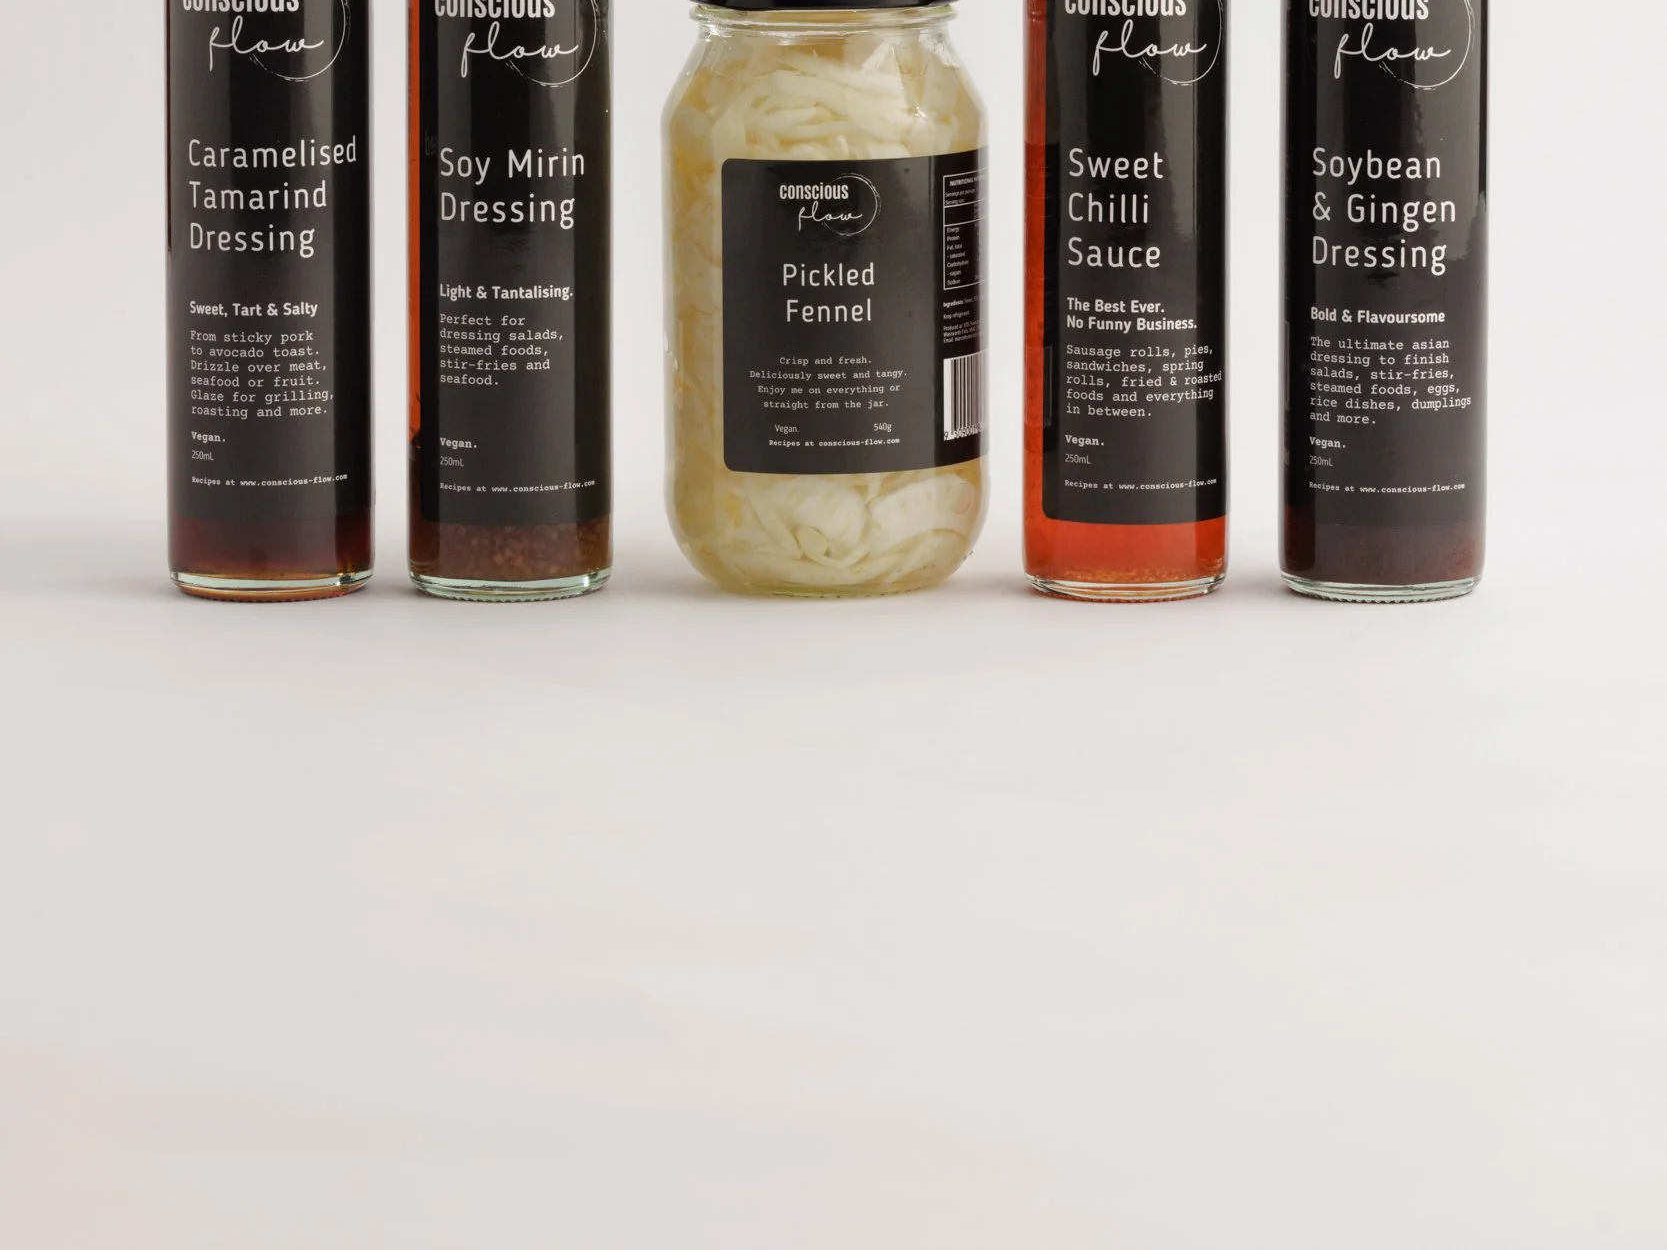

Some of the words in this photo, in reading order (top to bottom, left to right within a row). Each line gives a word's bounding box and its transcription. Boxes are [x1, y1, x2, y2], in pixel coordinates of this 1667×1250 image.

[209, 15, 324, 71] flow
[461, 21, 579, 78] flow
[1093, 19, 1207, 76] flow
[1334, 23, 1451, 79] flow
[188, 135, 357, 168] Caramelised
[440, 147, 490, 185] Soy
[508, 148, 585, 178] Mirin
[1069, 148, 1164, 179] Sweet
[1313, 147, 1441, 186] Soybean
[189, 179, 327, 210] Tamarind
[779, 182, 849, 200] conscious
[441, 192, 575, 230] Dressing
[1068, 192, 1148, 223] Chilli
[1313, 191, 1331, 221] &
[798, 201, 863, 231] flow
[190, 222, 315, 258] Dressing
[1068, 237, 1161, 268] Sauce
[1313, 236, 1447, 276] Dressing
[783, 262, 875, 287] Pickled
[440, 284, 472, 301] Light
[476, 286, 487, 299] &
[492, 285, 573, 301] Tantalising.
[190, 300, 228, 318] Sweet,
[232, 303, 262, 316] Tart
[267, 303, 278, 316] &
[283, 302, 318, 317] Salty
[787, 298, 872, 322] Fennel
[1067, 297, 1090, 311] The
[1095, 299, 1125, 313] Best
[1131, 300, 1165, 313] Ever.
[440, 314, 492, 326] Perfect
[501, 316, 526, 326] for
[1311, 307, 1336, 322] Bold
[1342, 310, 1352, 323] &
[1357, 310, 1446, 324] Flavoursome
[1067, 315, 1083, 329] No
[1089, 317, 1131, 333] Funny
[1137, 318, 1197, 330] Business.
[191, 330, 216, 342] From
[223, 332, 272, 345] sticky
[281, 331, 313, 344] pork
[440, 328, 501, 343] dressing
[509, 330, 564, 341] salads,
[440, 344, 492, 355] steamed
[501, 345, 548, 356] foods,
[1311, 337, 1331, 348] The
[1339, 339, 1404, 350] ultimate
[1412, 339, 1450, 350] asian
[191, 345, 202, 355] to
[209, 346, 264, 358] avocado
[273, 346, 319, 357] toast.
[1067, 345, 1121, 359] Sausage
[1130, 347, 1176, 358] rolls,
[1184, 345, 1213, 358] pies,
[191, 360, 239, 372] Drizzle
[248, 363, 280, 372] over
[289, 360, 327, 372] meat,
[440, 359, 517, 371] stir-fries
[526, 359, 550, 370] and
[779, 357, 808, 366] Crisp
[838, 356, 872, 364] fresh.
[1311, 351, 1370, 367] dressing
[1379, 355, 1395, 365] to
[1404, 354, 1449, 364] finish
[1067, 361, 1152, 373] sandwiches,
[1163, 360, 1204, 373] spring
[440, 374, 499, 385] seafood.
[750, 371, 812, 381] Deliciously
[876, 369, 907, 378] tangy.
[1067, 375, 1110, 387] rolls,
[1122, 376, 1162, 387] fried
[1170, 376, 1177, 386] &
[1185, 371, 1222, 385] roasted
[1311, 367, 1360, 381] salads,
[1371, 369, 1454, 380] stir-fries,
[191, 375, 239, 388] seafood
[248, 378, 264, 387] or
[274, 375, 320, 387] fruit.
[758, 385, 786, 395] Enjoy
[827, 385, 884, 395] everything
[1066, 389, 1104, 401] foods
[1112, 392, 1137, 402] and
[1146, 389, 1214, 403] everything
[1311, 382, 1361, 394] steamed
[1371, 384, 1417, 396] foods,
[1428, 385, 1460, 395] eggs,
[191, 389, 224, 402] Glaze
[232, 392, 256, 402] for
[265, 390, 334, 405] grilling,
[1310, 396, 1337, 407] rice
[1346, 399, 1401, 411] dishes,
[1412, 396, 1471, 411] dumplings
[764, 401, 808, 410] straight
[868, 400, 889, 409] jar.
[1066, 404, 1080, 415] in
[1088, 405, 1152, 417] between.
[191, 405, 248, 420] roasting
[257, 406, 282, 417] and
[290, 406, 327, 416] more.
[1310, 412, 1330, 422] and
[1337, 415, 1376, 424] more.
[873, 423, 892, 432] 540g
[191, 431, 226, 443] Vegan.
[440, 438, 478, 449] Vegan.
[769, 440, 800, 448] Recipes
[819, 438, 900, 447] conscious-flow.com
[1065, 435, 1105, 447] Vegan.
[1309, 437, 1346, 449] Vegan.
[192, 450, 214, 461] 250mL
[440, 456, 464, 467] 250mL
[1065, 454, 1091, 465] 250mL
[1309, 456, 1333, 466] 250mL
[192, 477, 221, 487] Recipes
[240, 473, 348, 487] www.conscious-flow.com
[440, 482, 471, 492] Recipes
[491, 480, 595, 492] www.conscious-flow.com
[1065, 480, 1097, 489] Recipes
[1119, 478, 1217, 490] www.conscious-flow.com
[1309, 482, 1339, 491] Recipes
[1360, 483, 1465, 493] www.conscious-flow.com
